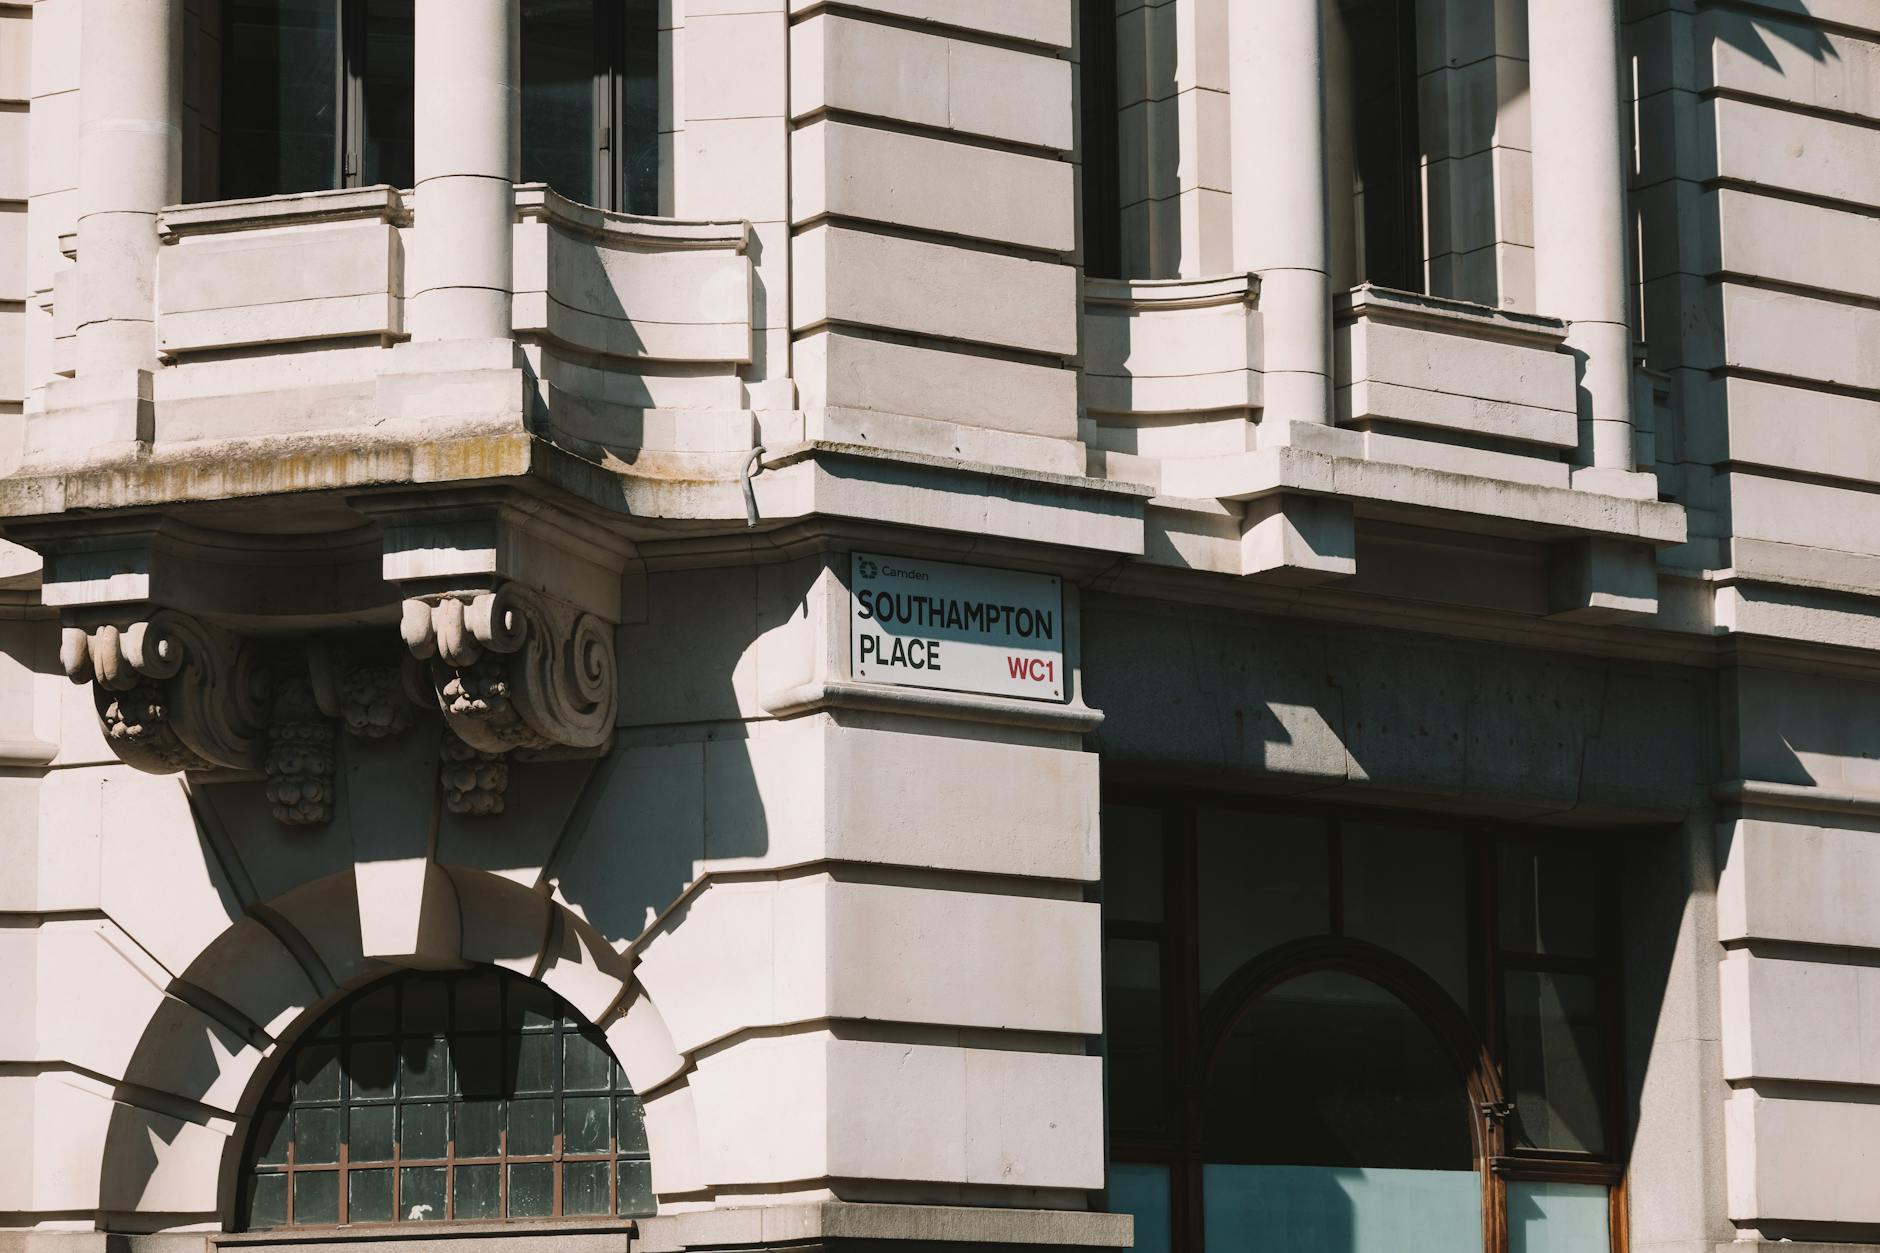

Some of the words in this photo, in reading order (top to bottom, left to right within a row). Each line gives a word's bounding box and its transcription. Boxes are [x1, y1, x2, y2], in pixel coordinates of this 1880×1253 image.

[881, 565, 929, 581] Camden
[857, 589, 1053, 640] SOUTHAMPTON
[860, 634, 941, 671] PLACE
[1007, 656, 1054, 682] WC1
